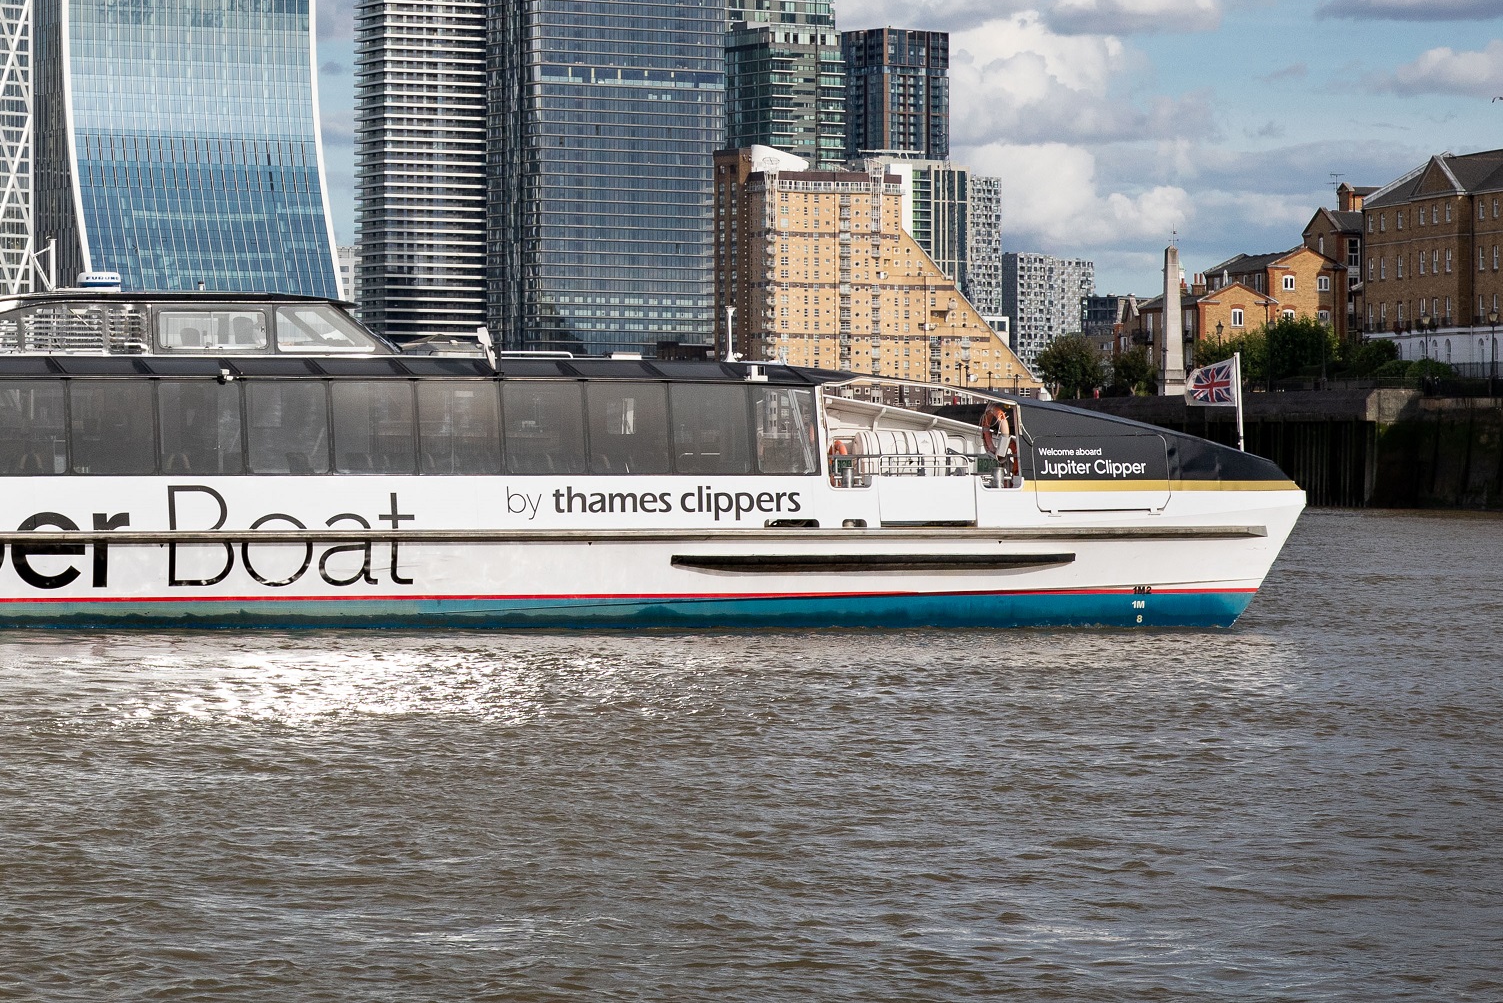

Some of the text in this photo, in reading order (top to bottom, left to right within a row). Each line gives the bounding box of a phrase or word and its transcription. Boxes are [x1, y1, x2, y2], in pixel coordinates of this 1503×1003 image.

[1038, 447, 1103, 456] Welcome aboard
[1040, 459, 1147, 478] Jupiter Clipper
[506, 485, 802, 521] by thames clippers
[167, 485, 415, 588] Boat
[1131, 600, 1145, 609] 1M
[1136, 614, 1143, 623] 8
